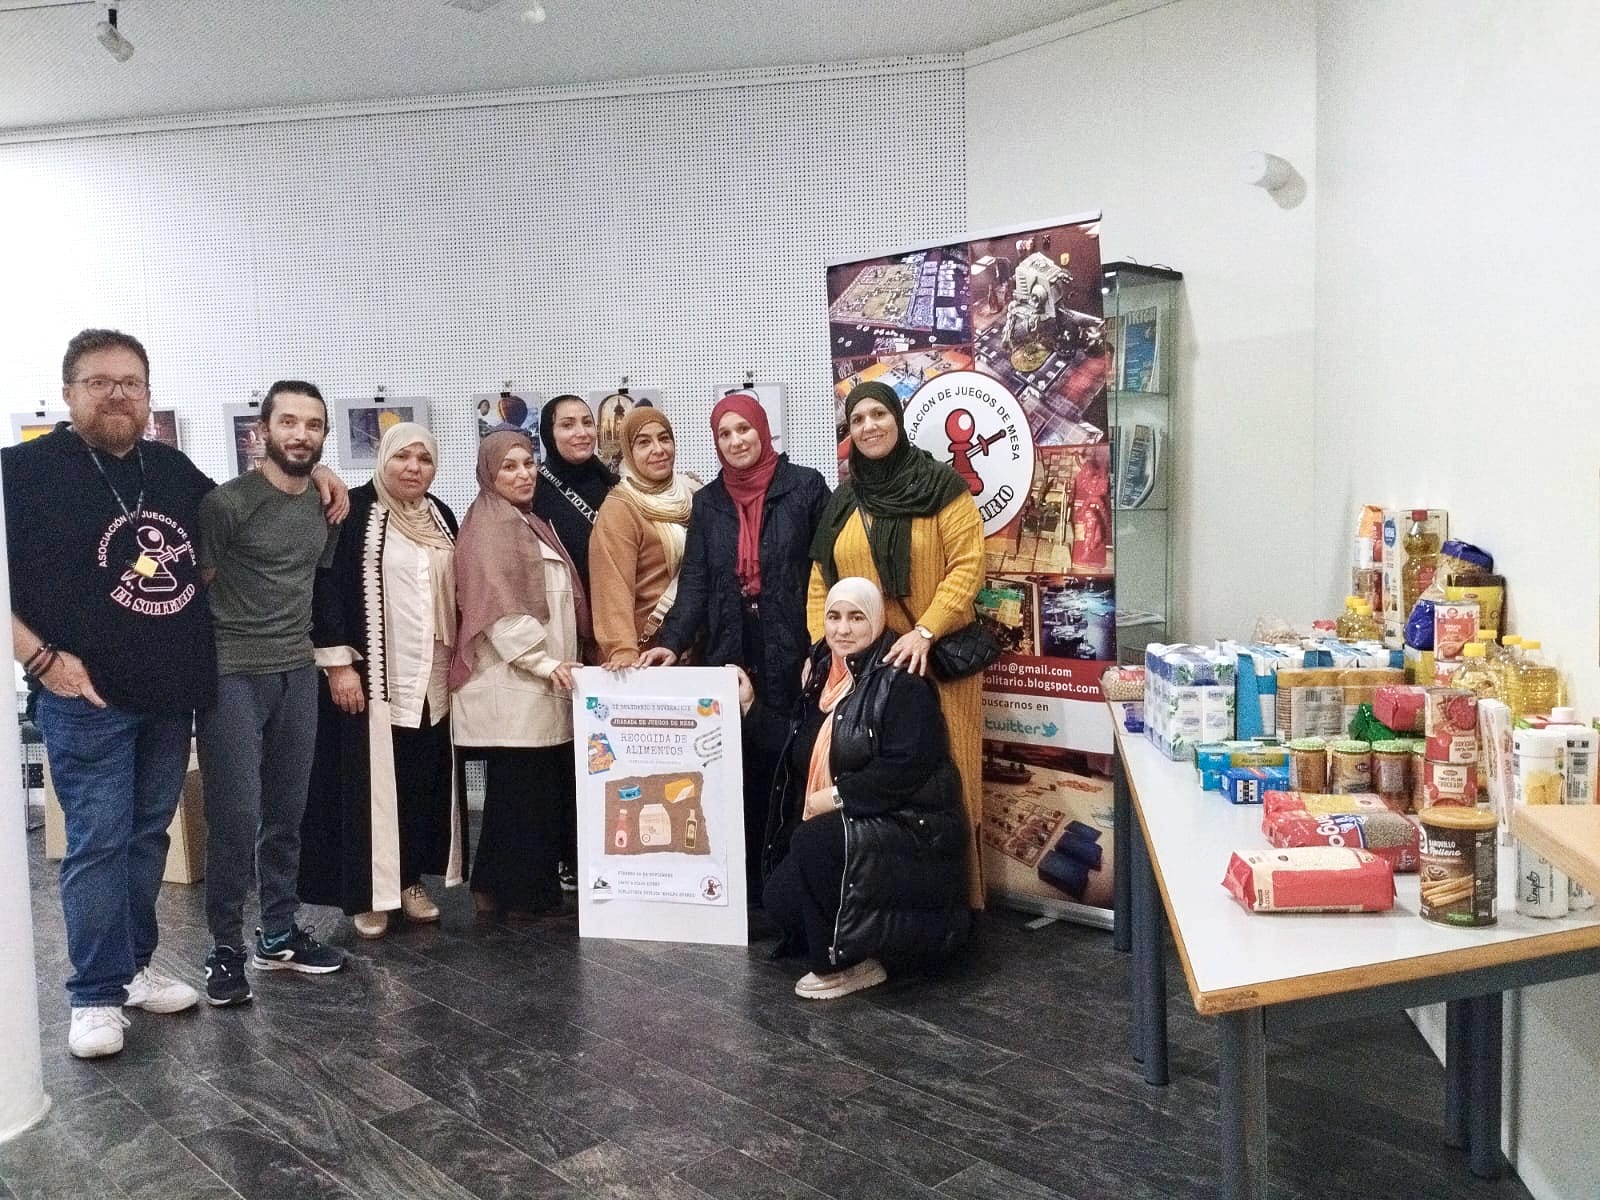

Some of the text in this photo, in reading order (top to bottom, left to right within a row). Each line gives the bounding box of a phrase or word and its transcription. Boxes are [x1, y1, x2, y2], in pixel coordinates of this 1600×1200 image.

[938, 388, 952, 401] DE
[955, 386, 997, 408] JUEGOS
[997, 406, 1011, 423] DE
[1006, 424, 1020, 461] MESA
[98, 514, 127, 568] ASOCIACIÓN
[141, 510, 178, 529] JUEGOS
[177, 527, 188, 540] DE
[186, 540, 197, 566] MESA
[110, 583, 195, 615] EL SOLITARIO
[987, 661, 1072, 677] ario@gmail.com
[982, 696, 1049, 712] buscarnos en
[984, 717, 1041, 735] twitter
[620, 733, 688, 744] RECOGIDA DE
[626, 744, 684, 756] ALIMENTOS
